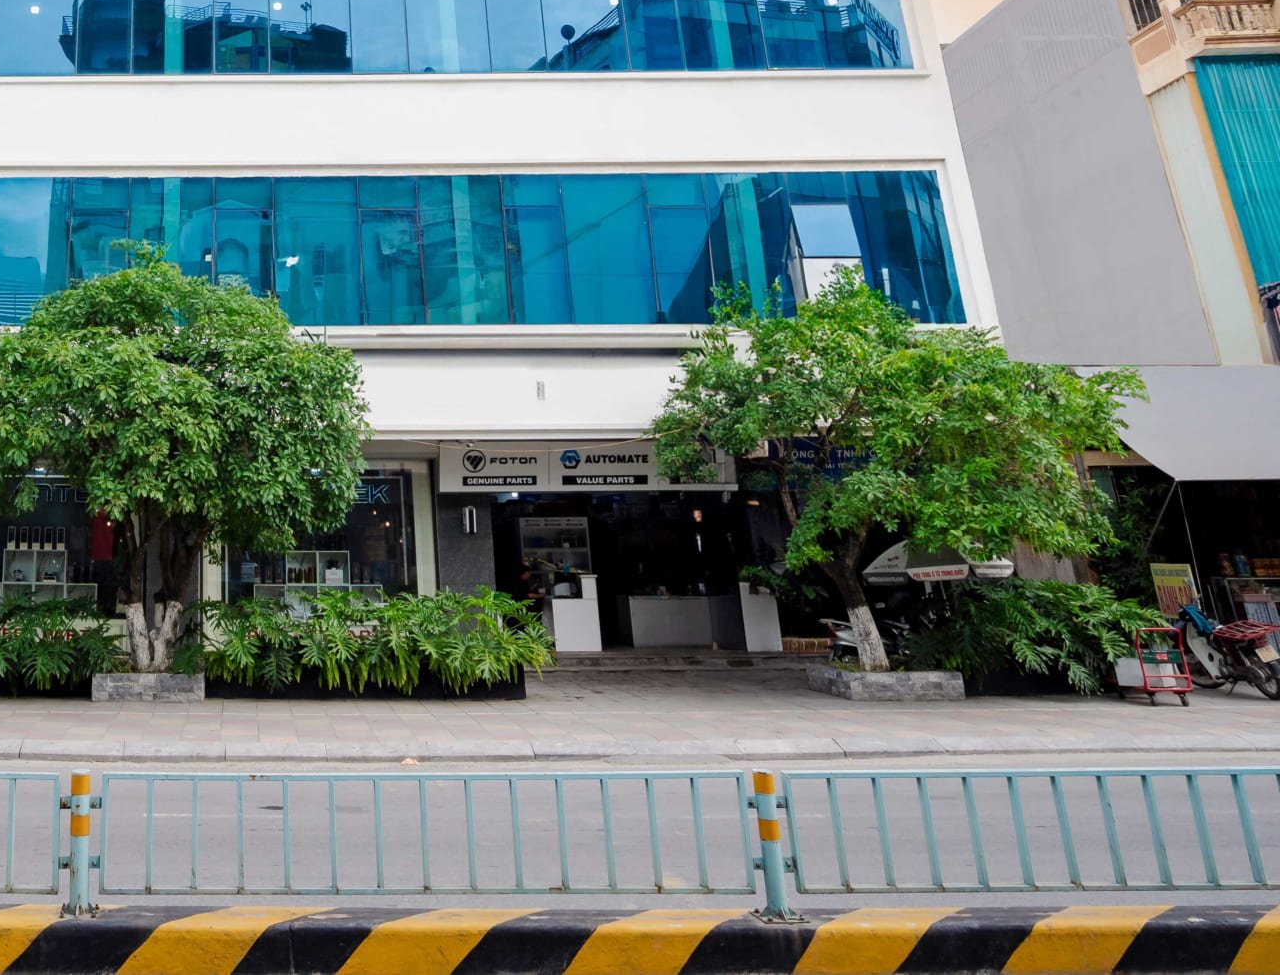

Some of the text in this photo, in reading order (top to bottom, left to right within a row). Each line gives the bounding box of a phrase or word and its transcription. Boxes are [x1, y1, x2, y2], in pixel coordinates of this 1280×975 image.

[490, 456, 538, 465] FOTON
[585, 454, 649, 464] AUTOMATE
[466, 477, 533, 485] GENUINE PARTS
[576, 476, 635, 484] VALUE PARTS
